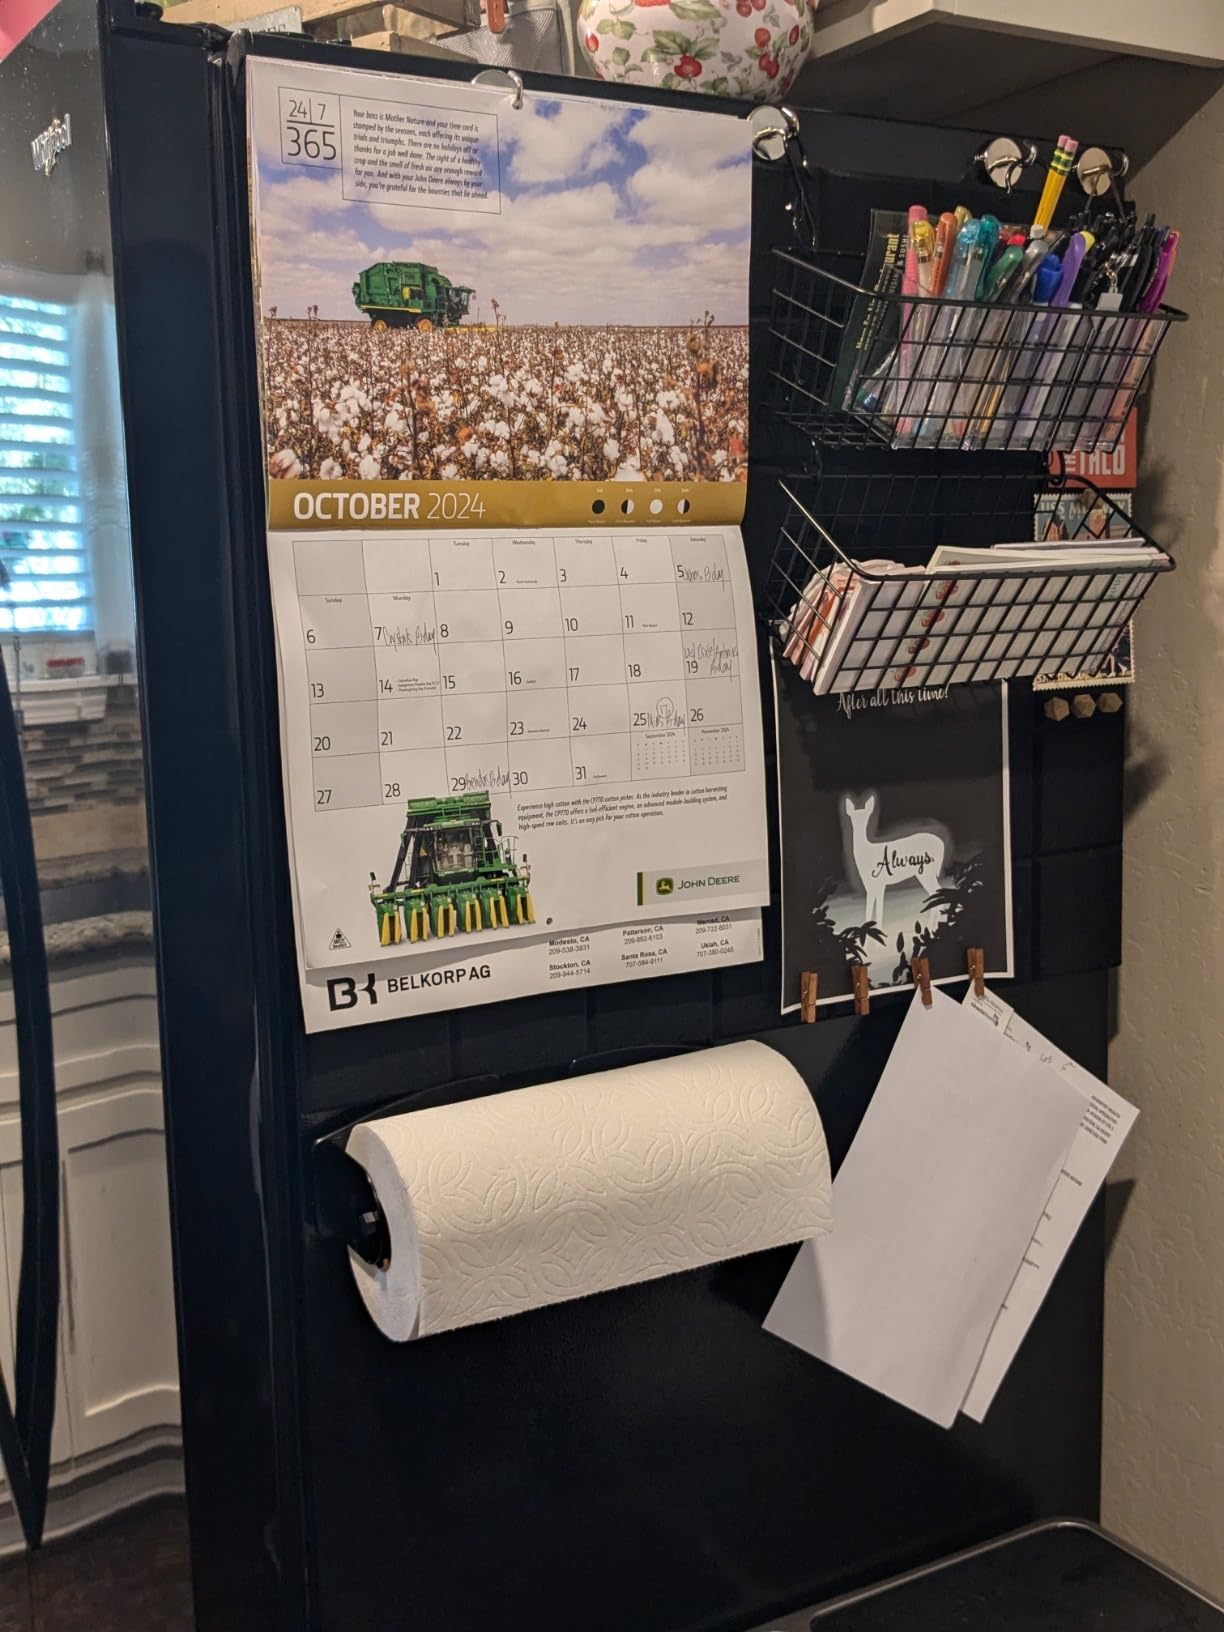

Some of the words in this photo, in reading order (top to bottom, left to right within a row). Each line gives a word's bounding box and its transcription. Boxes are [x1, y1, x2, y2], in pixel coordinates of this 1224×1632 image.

[289, 100, 307, 118] 24
[353, 109, 364, 117] Your
[384, 113, 404, 122] Mother
[405, 116, 424, 125] Nature
[436, 121, 448, 129] your
[461, 123, 474, 131] card
[353, 121, 376, 132] stamped
[377, 123, 384, 133] by
[384, 124, 394, 132] the
[431, 130, 453, 141] offering
[287, 126, 336, 160] 365
[353, 132, 367, 141] trials
[368, 134, 379, 142] and
[407, 139, 422, 147] There
[440, 142, 462, 153] holidays
[353, 144, 372, 153] thanks
[386, 148, 396, 158] job
[425, 152, 435, 160] The
[435, 153, 449, 163] sight
[461, 156, 481, 167] healthy
[411, 162, 424, 170] fresh
[443, 166, 462, 176] enough
[463, 167, 483, 176] reward
[354, 167, 362, 175] for
[377, 169, 388, 177] And
[401, 174, 414, 182] your
[414, 173, 427, 181] John
[427, 175, 443, 183] Deere
[444, 177, 462, 187] always
[463, 179, 470, 187] by
[469, 181, 483, 189] your
[385, 182, 408, 193] grateful
[408, 184, 416, 192] for
[417, 185, 427, 193] the
[293, 492, 420, 520] OCTOBER
[426, 492, 486, 519] 2024
[498, 571, 507, 584] 2
[560, 569, 567, 582] 3
[620, 567, 628, 579] 4
[677, 565, 684, 578] 5
[434, 572, 440, 586] 1
[565, 618, 578, 631] 10
[625, 615, 634, 628] 11
[682, 612, 693, 626] 12
[374, 627, 382, 641] 7
[440, 624, 449, 638] 8
[504, 621, 513, 634] 9
[307, 629, 316, 644] 6
[628, 664, 641, 677] 18
[686, 660, 698, 674] 19
[508, 671, 522, 685] 16
[569, 668, 580, 681] 17
[379, 680, 393, 693] 14
[443, 675, 456, 689] 15
[311, 684, 324, 698] 13
[836, 692, 868, 719] After
[870, 689, 889, 707] all
[891, 689, 914, 705] this
[633, 713, 646, 726] 25
[690, 708, 704, 721] 26
[510, 722, 524, 735] 23
[572, 717, 587, 730] 24
[381, 732, 393, 745] 21
[447, 727, 462, 741] 22
[314, 737, 331, 751] 20
[512, 772, 528, 785] 30
[575, 767, 586, 780] 31
[385, 784, 400, 798] 28
[452, 778, 466, 791] 29
[317, 790, 332, 804] 27
[678, 879, 706, 890] JOHN
[708, 875, 740, 886] DEERE
[621, 953, 638, 961] Santa
